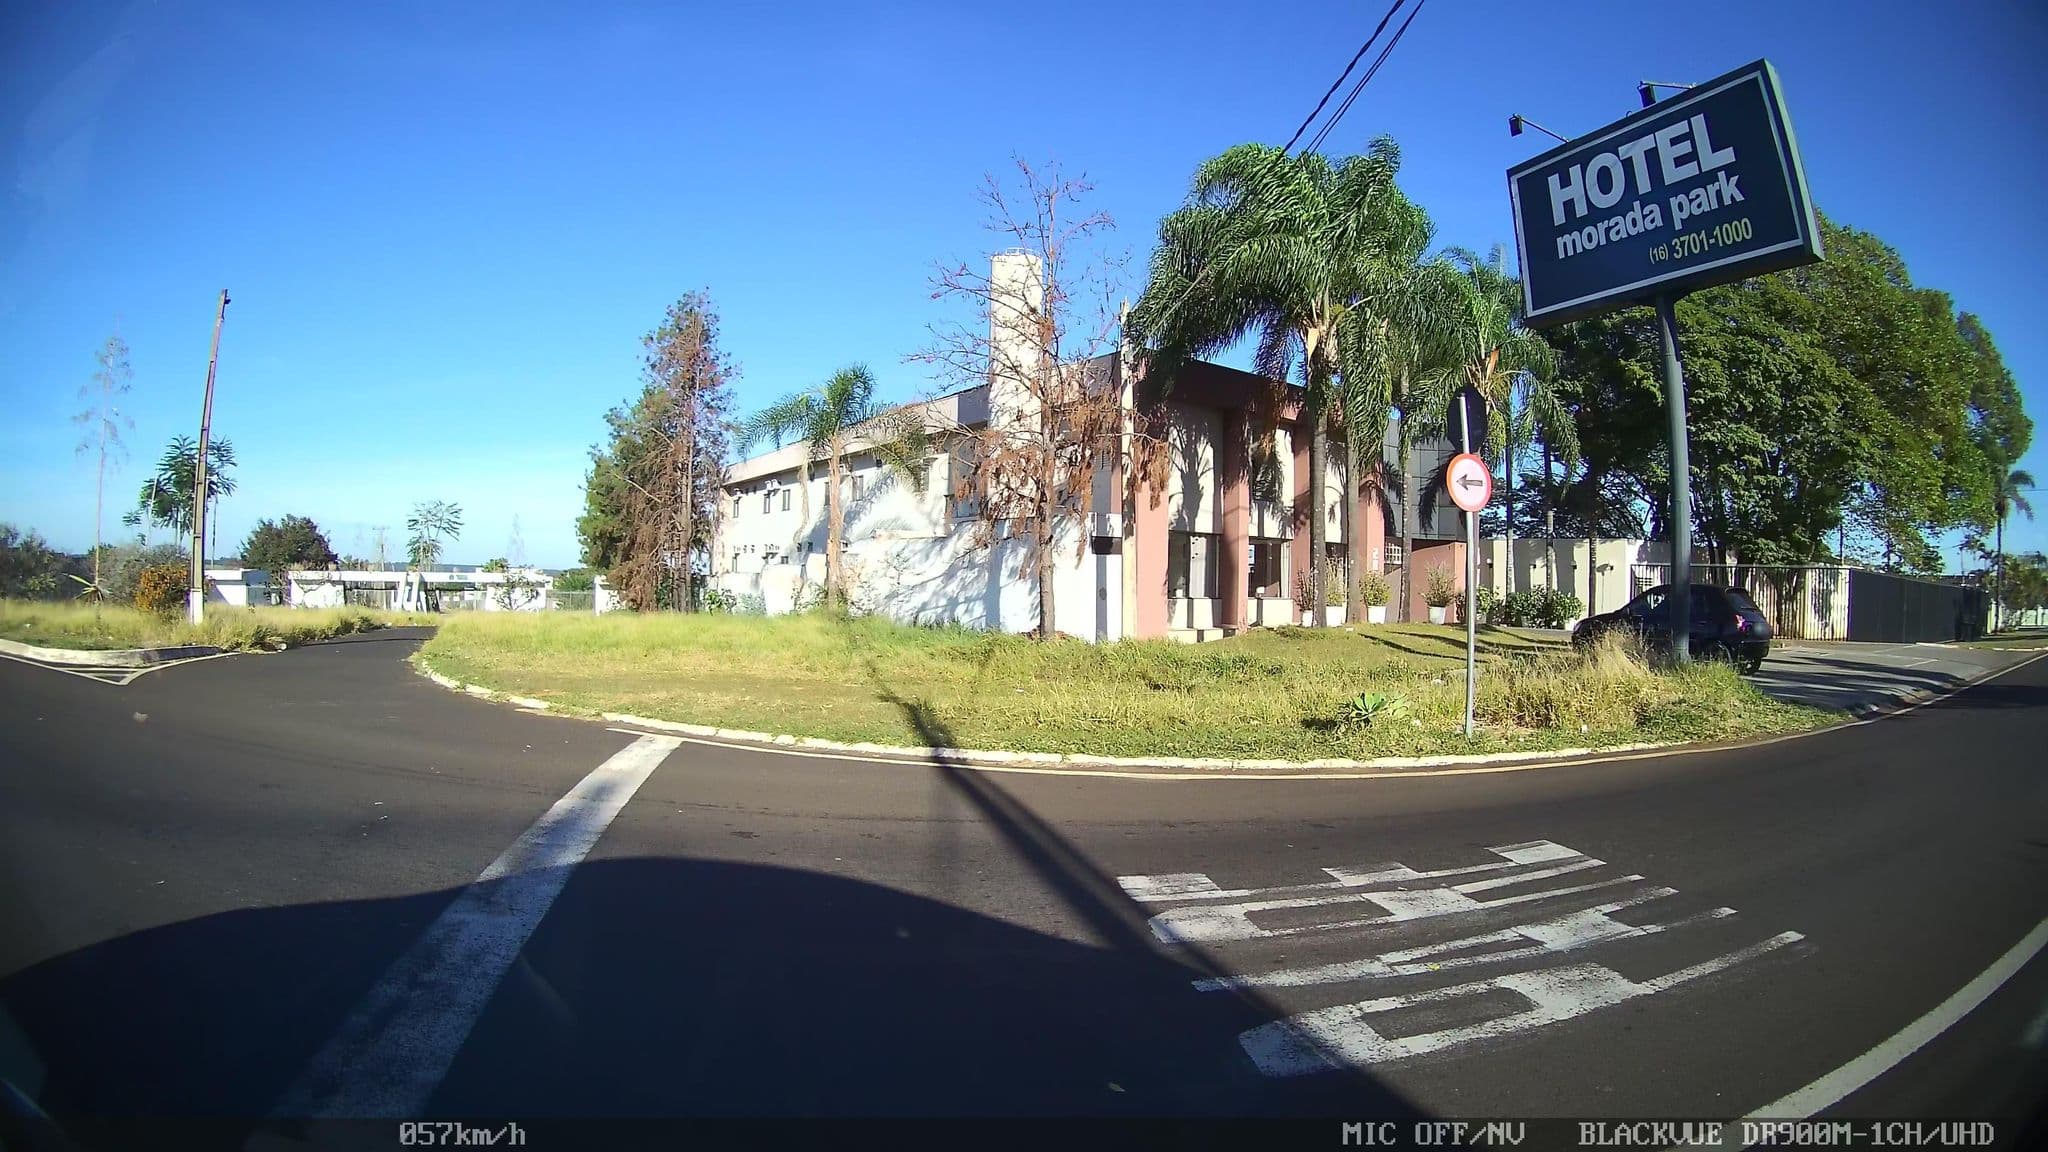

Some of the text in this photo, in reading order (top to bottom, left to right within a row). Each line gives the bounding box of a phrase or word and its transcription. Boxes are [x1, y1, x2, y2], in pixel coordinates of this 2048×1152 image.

[1547, 113, 1736, 227] HOTEL
[1556, 170, 1745, 259] morada park
[1649, 217, 1753, 264] (16) 3701-1000
[1117, 840, 1806, 1077] PARE
